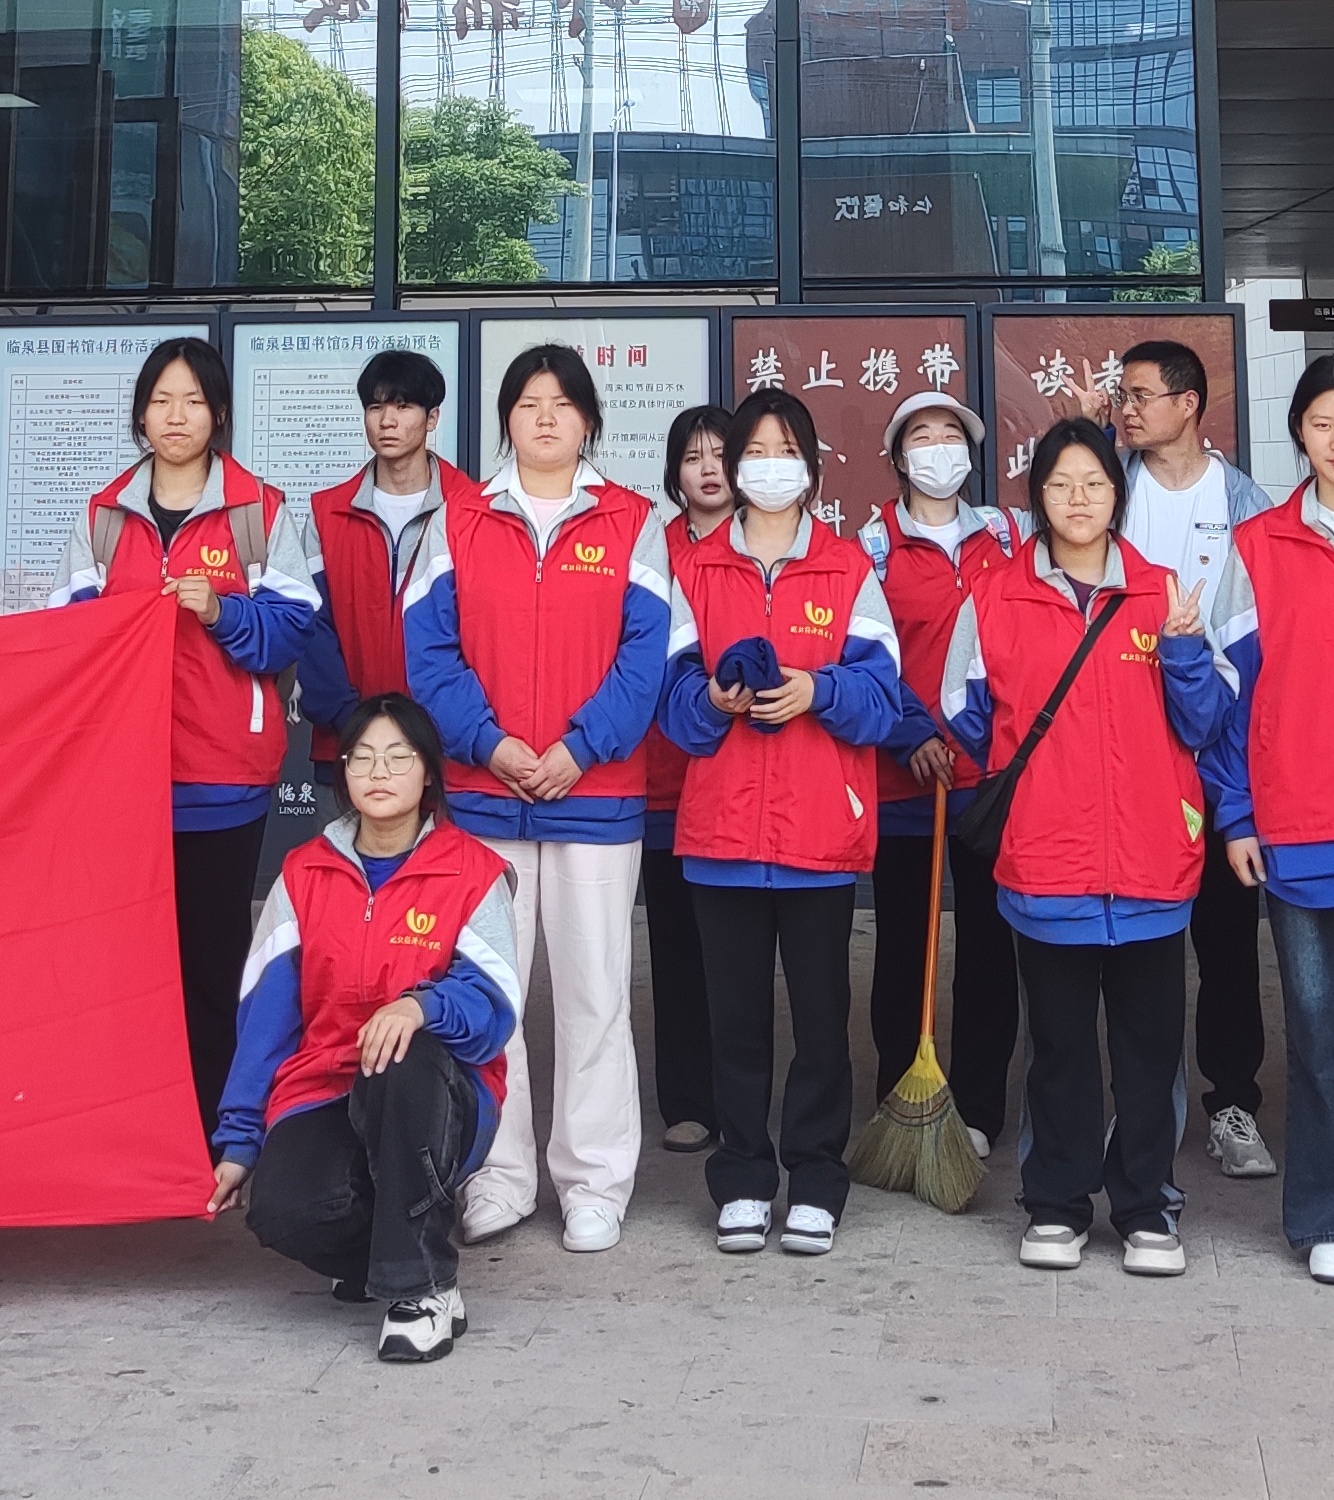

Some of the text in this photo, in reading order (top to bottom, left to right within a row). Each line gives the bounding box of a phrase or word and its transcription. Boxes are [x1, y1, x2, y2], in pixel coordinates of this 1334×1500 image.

[250, 335, 442, 352] 临泉县图书馆5月份活动预告
[745, 343, 960, 395] 禁止携带
[278, 781, 318, 804] 临泉
